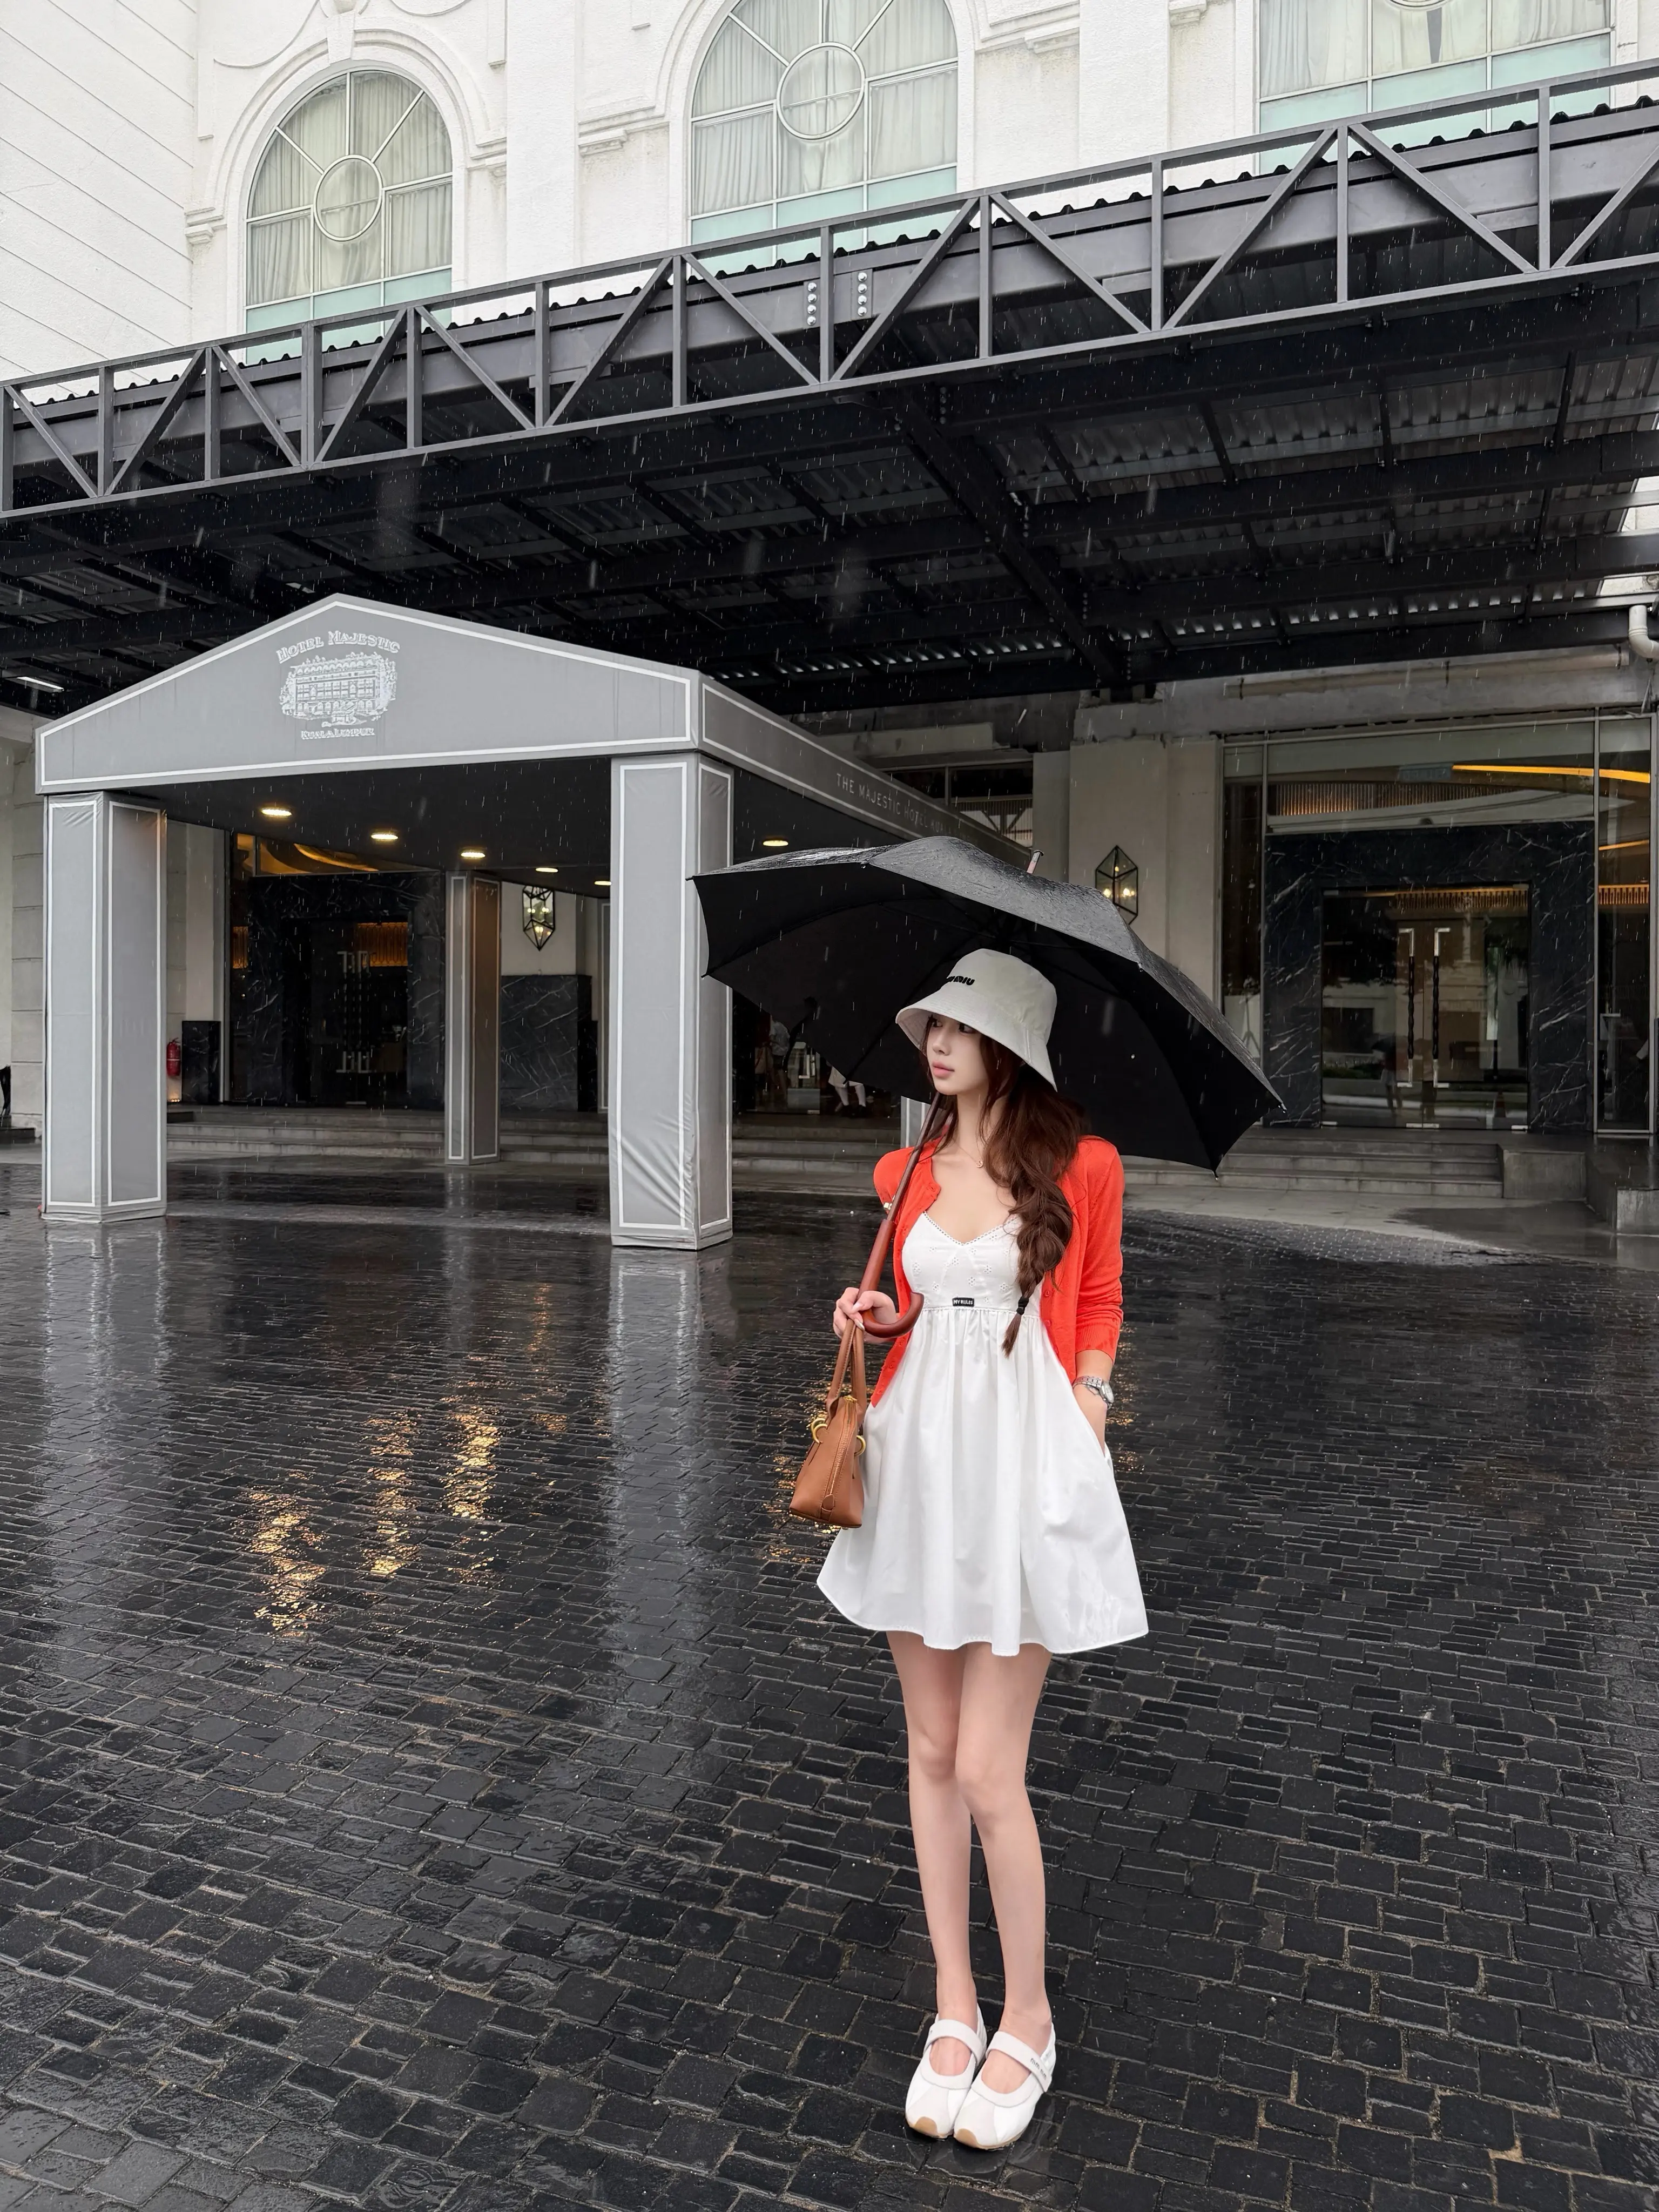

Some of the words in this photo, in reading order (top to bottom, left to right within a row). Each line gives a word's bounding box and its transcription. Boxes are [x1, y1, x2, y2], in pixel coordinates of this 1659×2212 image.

[276, 636, 325, 664] HOTEL
[328, 630, 400, 653] MAJESTIC
[301, 730, 334, 740] KUALA
[334, 727, 375, 737] LUMPUR
[837, 773, 854, 794] THE
[859, 784, 901, 815] MAJESTIC
[904, 805, 928, 828] HOTEL
